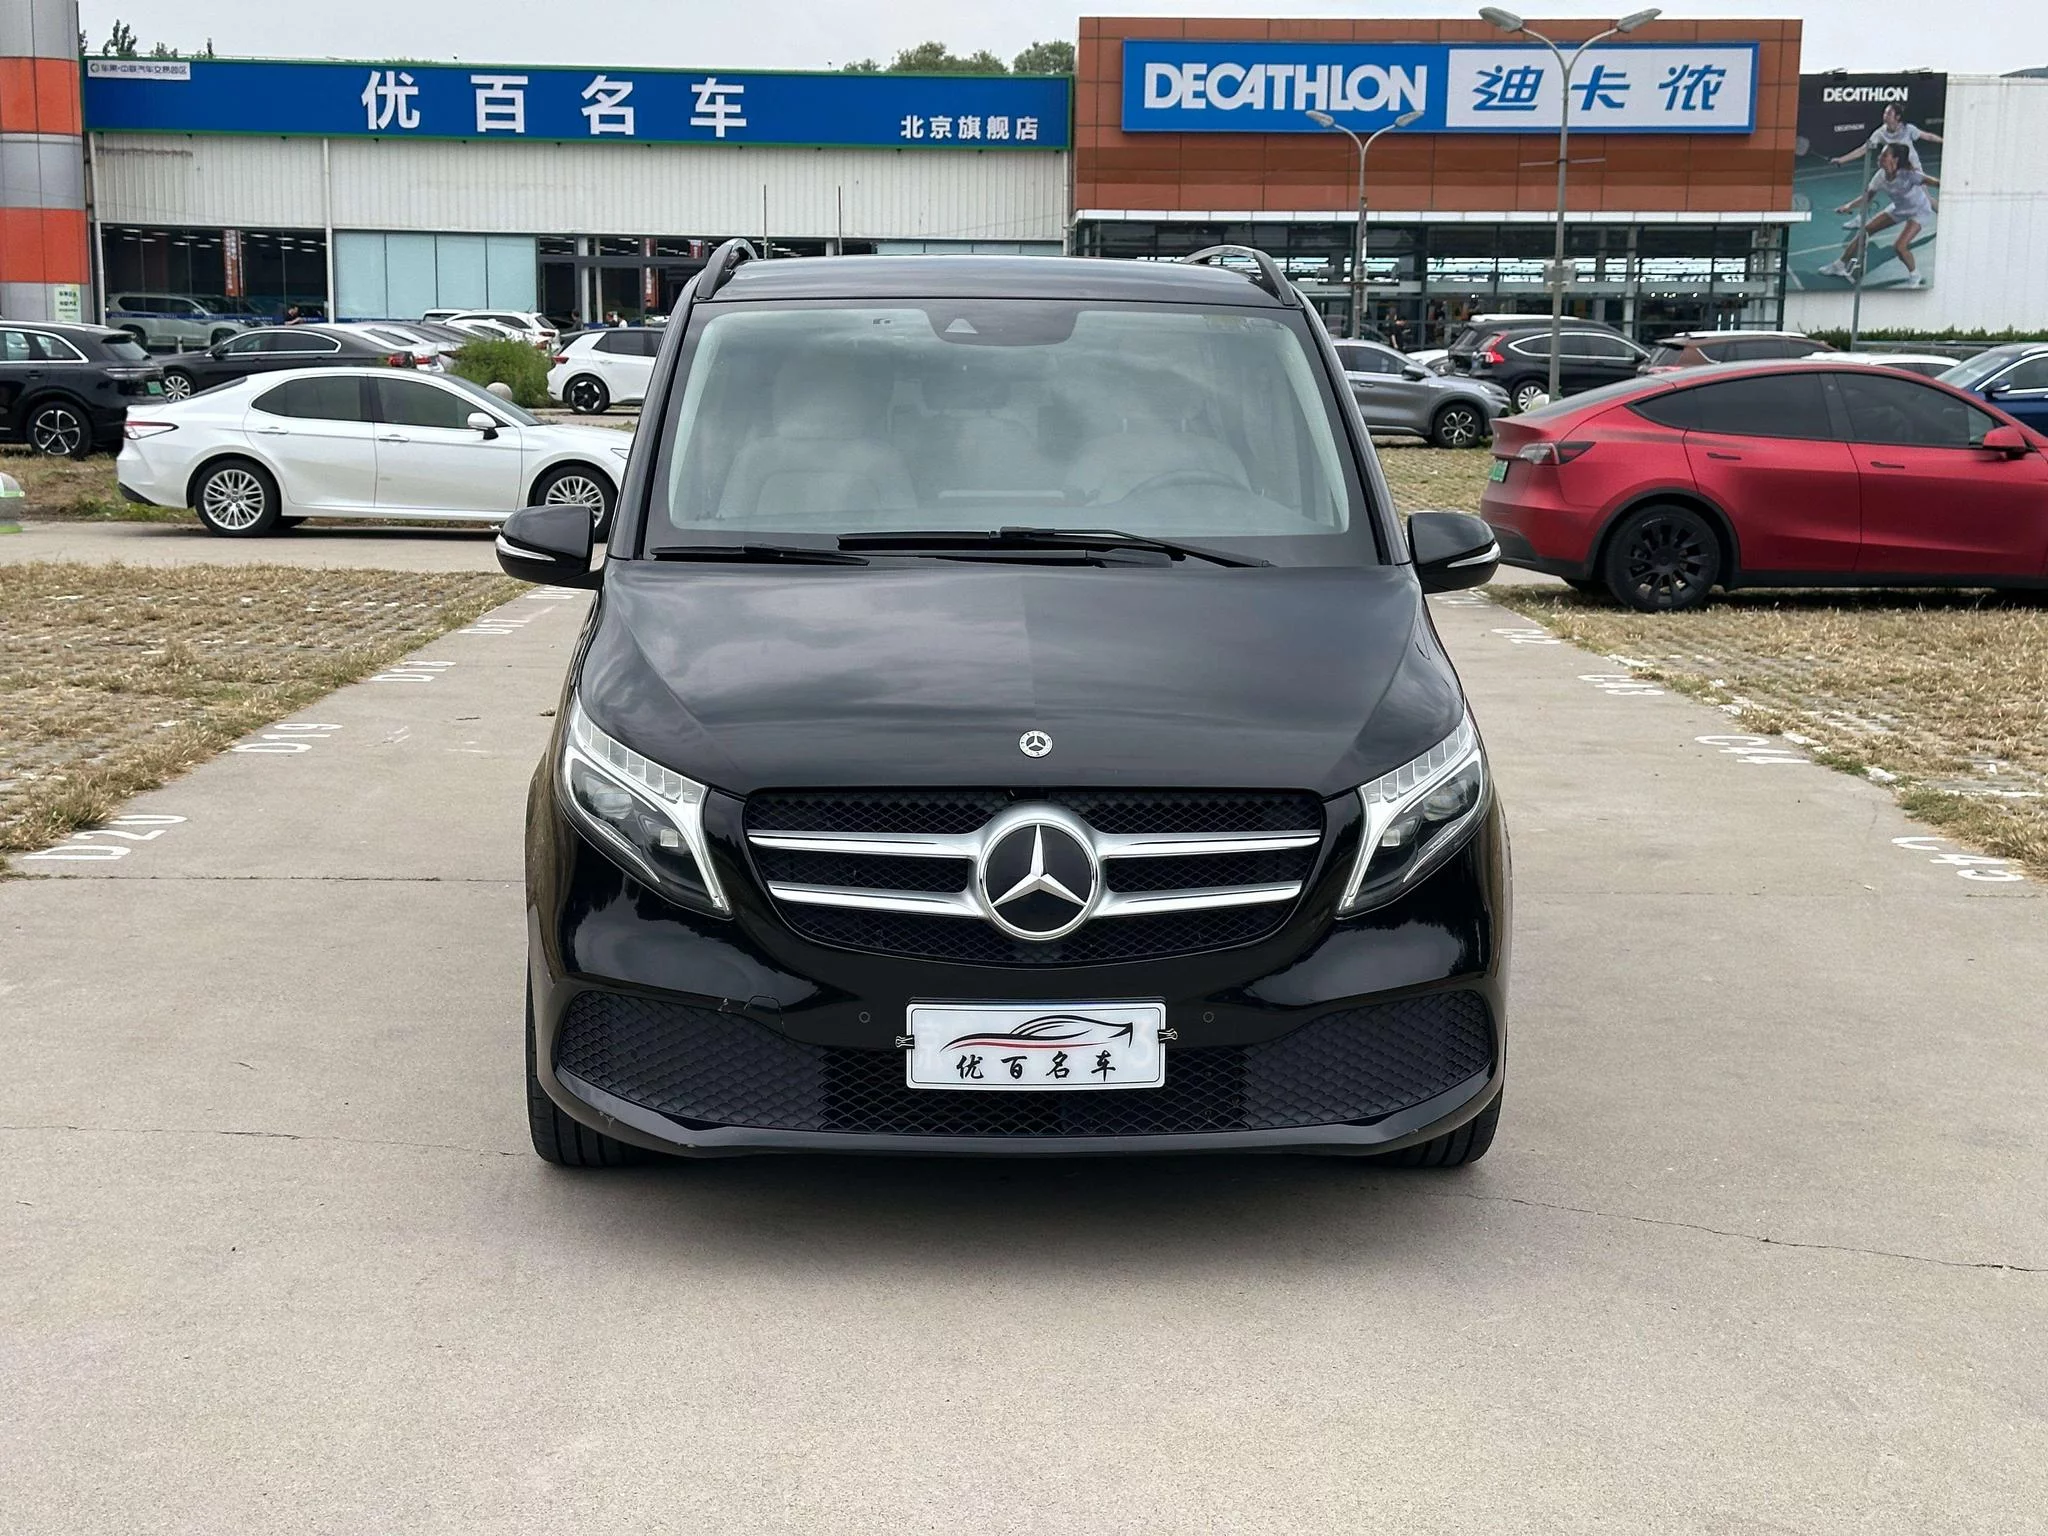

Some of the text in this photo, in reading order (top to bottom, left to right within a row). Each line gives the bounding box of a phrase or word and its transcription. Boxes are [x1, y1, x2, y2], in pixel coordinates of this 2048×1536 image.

[1144, 63, 1428, 111] DECATHLON
[1472, 64, 1728, 112] 迪卡侬
[1823, 87, 1909, 102] DECATHLON
[361, 71, 748, 138] 优百名车
[900, 114, 1039, 141] 北京旗舰店
[368, 661, 457, 682] D18
[231, 723, 344, 753] D19
[22, 814, 188, 860] D20
[956, 1050, 1117, 1082] 优百名车
